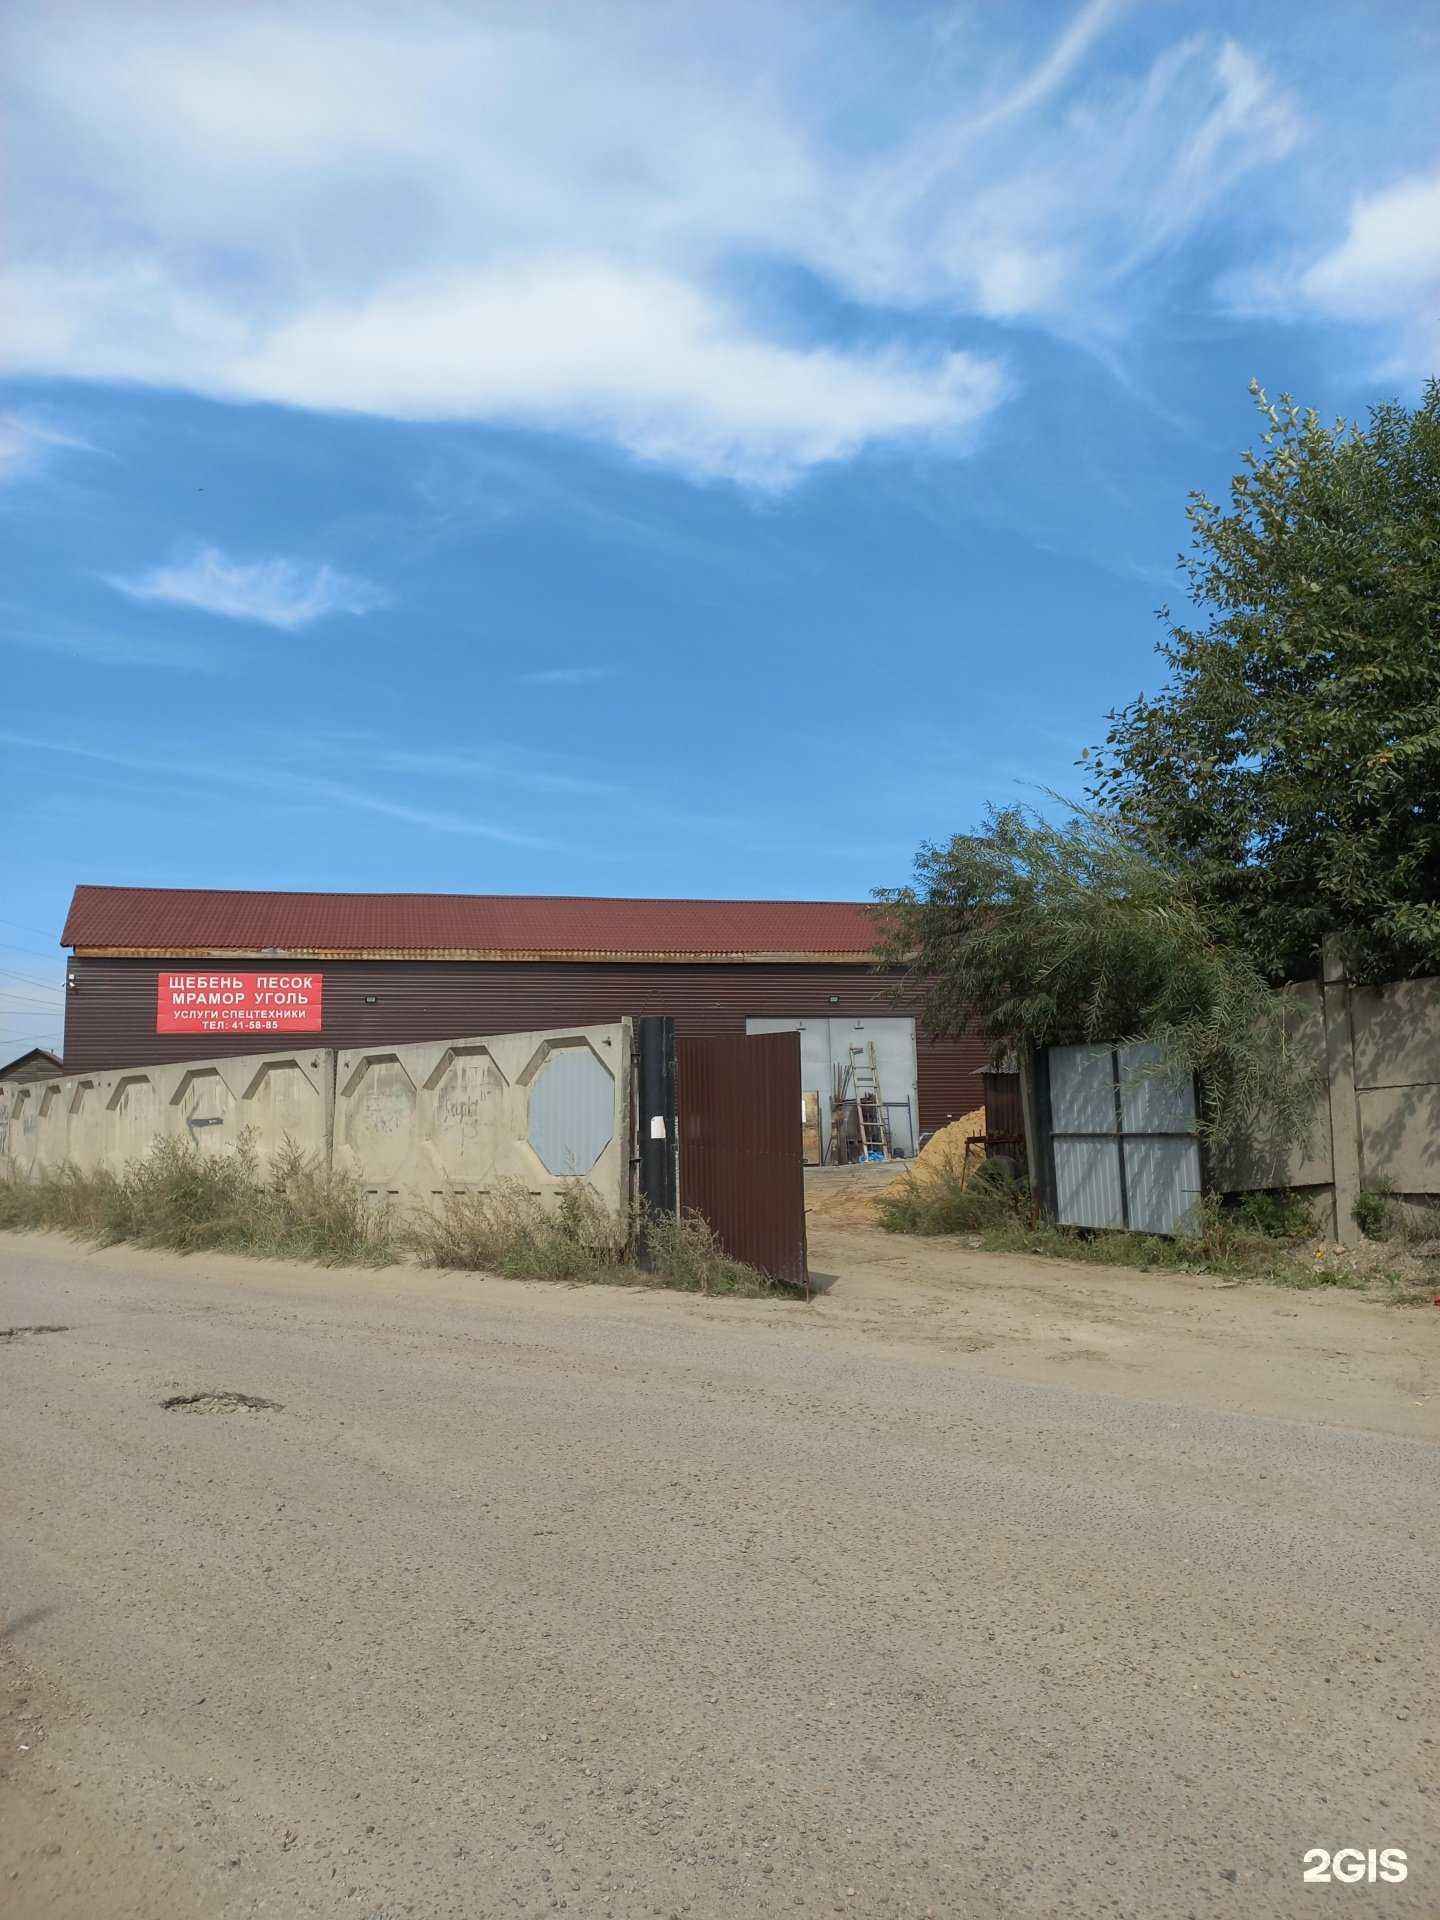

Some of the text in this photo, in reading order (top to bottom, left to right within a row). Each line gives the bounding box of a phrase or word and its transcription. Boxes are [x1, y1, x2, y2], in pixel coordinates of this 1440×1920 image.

[169, 976, 313, 990] ЩЕБЕНЬ ПЕСОК
[172, 992, 309, 1005] МРАМОР УГОЛЬ
[174, 1010, 306, 1020] УСЛУГИ СПЕЦТЕХНИКИ
